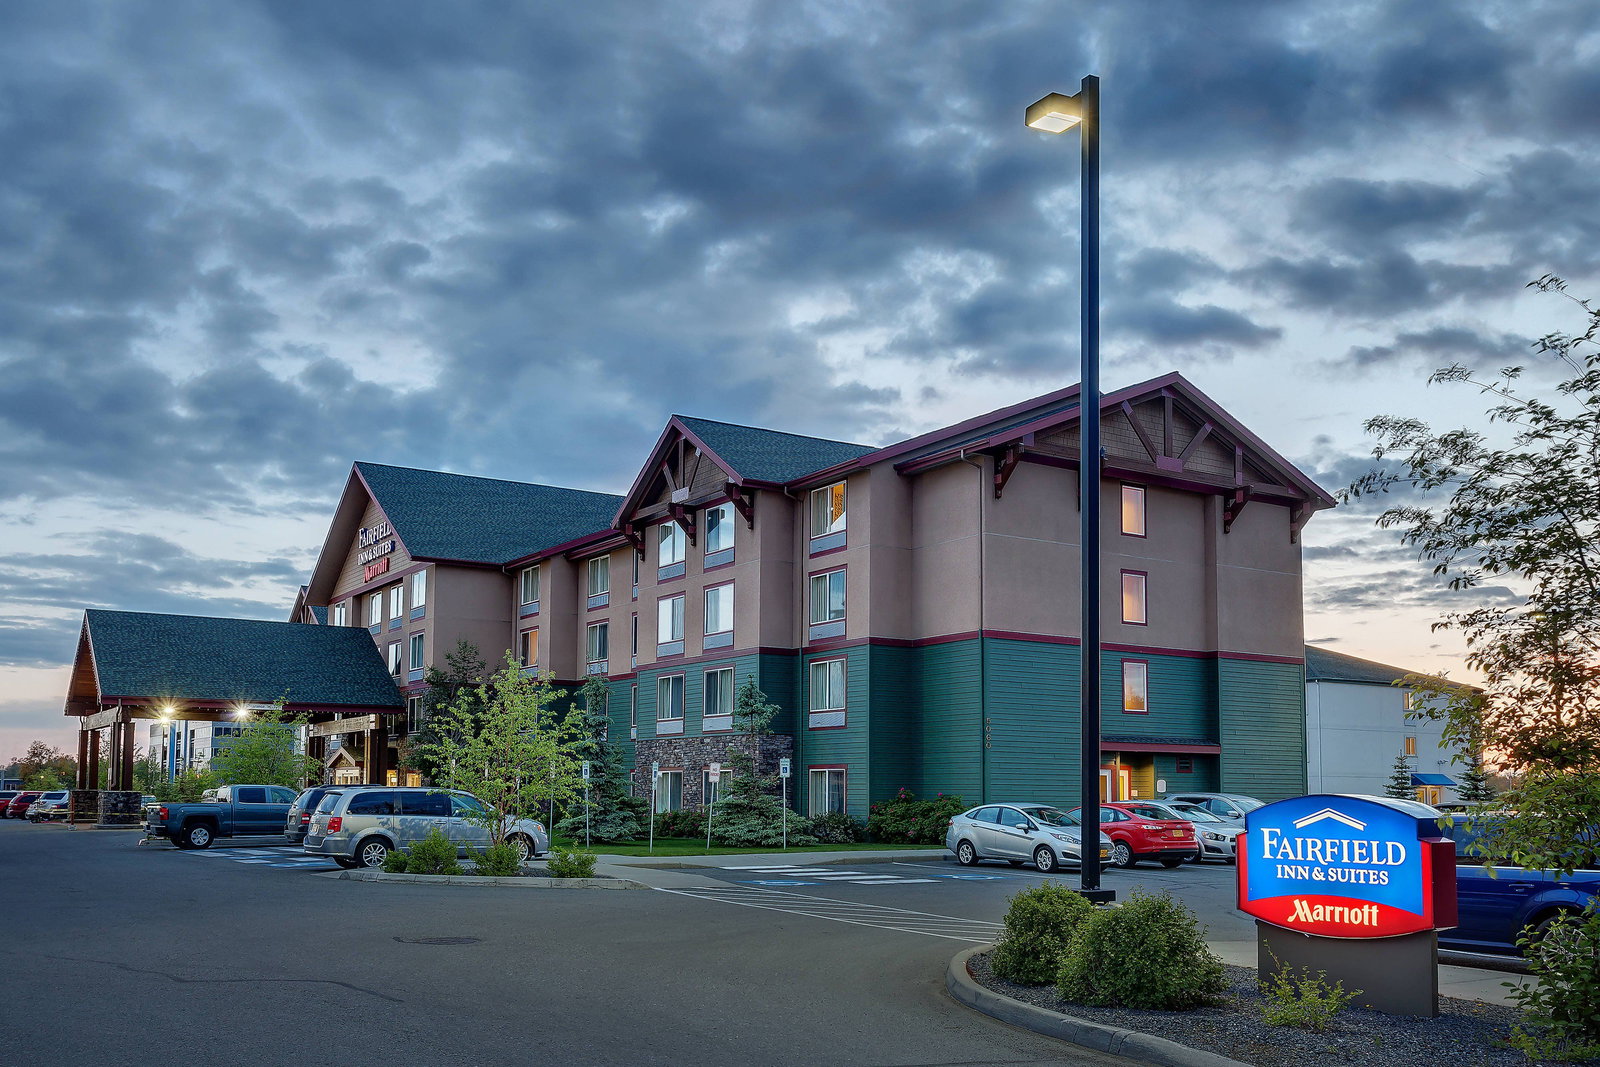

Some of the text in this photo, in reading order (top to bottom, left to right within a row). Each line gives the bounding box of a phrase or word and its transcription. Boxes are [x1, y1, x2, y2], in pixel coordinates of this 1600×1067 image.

[358, 550, 369, 566] INN
[373, 540, 392, 559] SUITES
[363, 557, 388, 583] Marriott
[1260, 827, 1407, 866] FAIRFIELD
[1276, 864, 1389, 886] INN & SUITES
[1287, 899, 1379, 927] Marriott
